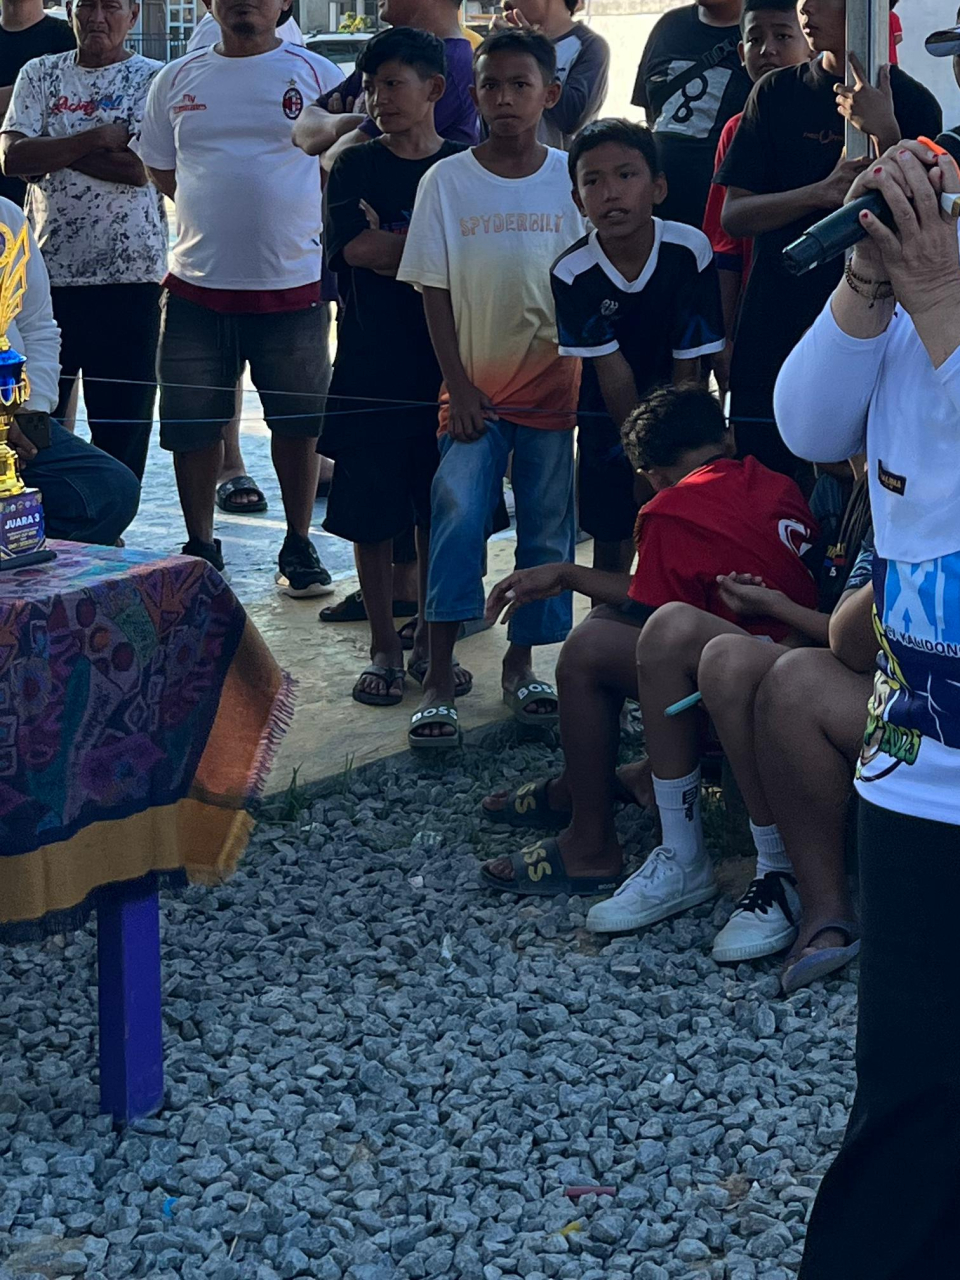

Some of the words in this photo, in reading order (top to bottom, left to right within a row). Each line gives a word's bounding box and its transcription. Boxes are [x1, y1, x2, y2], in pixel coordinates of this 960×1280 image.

[5, 515, 33, 529] JUARA
[34, 512, 40, 522] 3
[411, 705, 458, 723] BOSS
